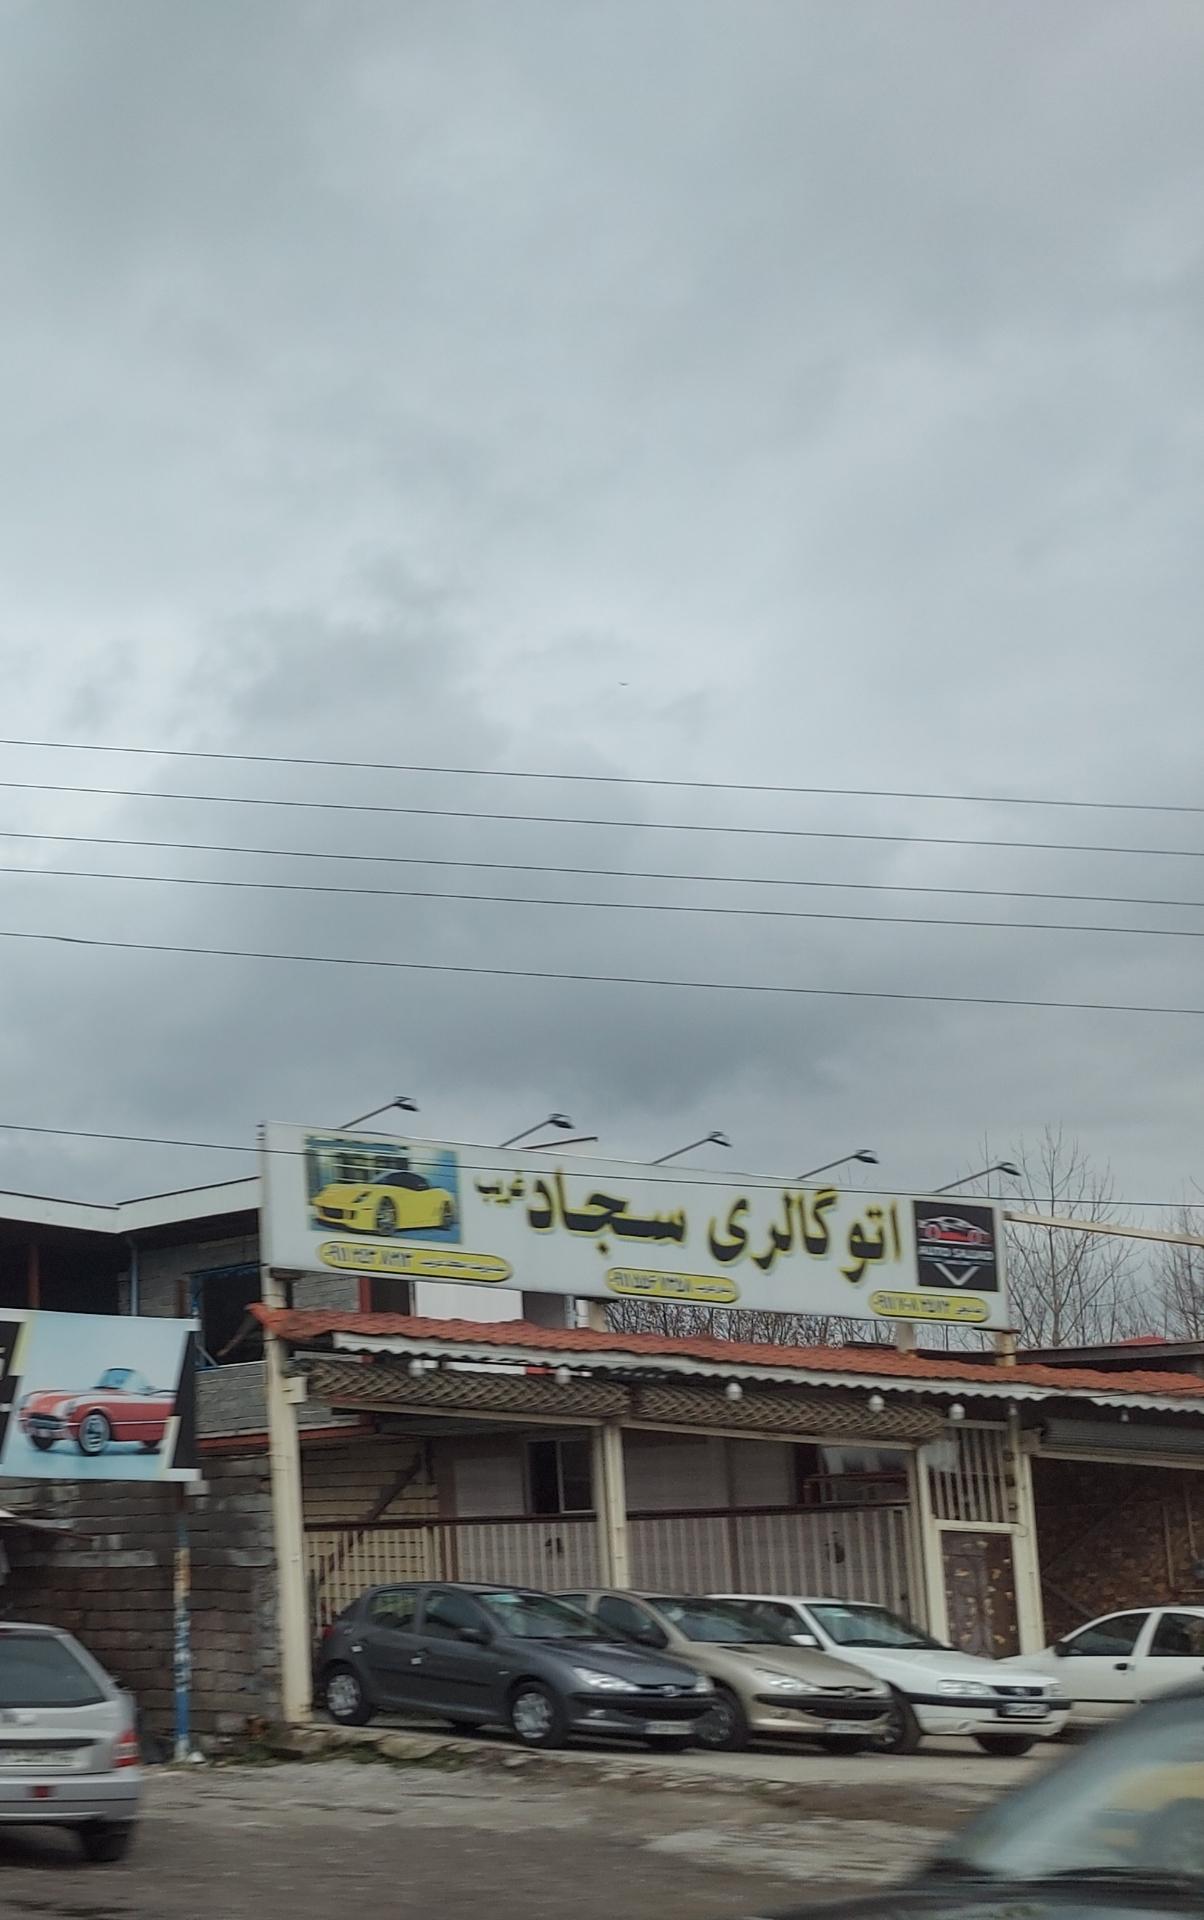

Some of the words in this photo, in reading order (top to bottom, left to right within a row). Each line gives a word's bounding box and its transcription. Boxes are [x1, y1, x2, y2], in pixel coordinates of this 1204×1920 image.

[528, 1167, 686, 1256] سجاد
[709, 1187, 837, 1273] گالری
[840, 1202, 900, 1284] اتو
